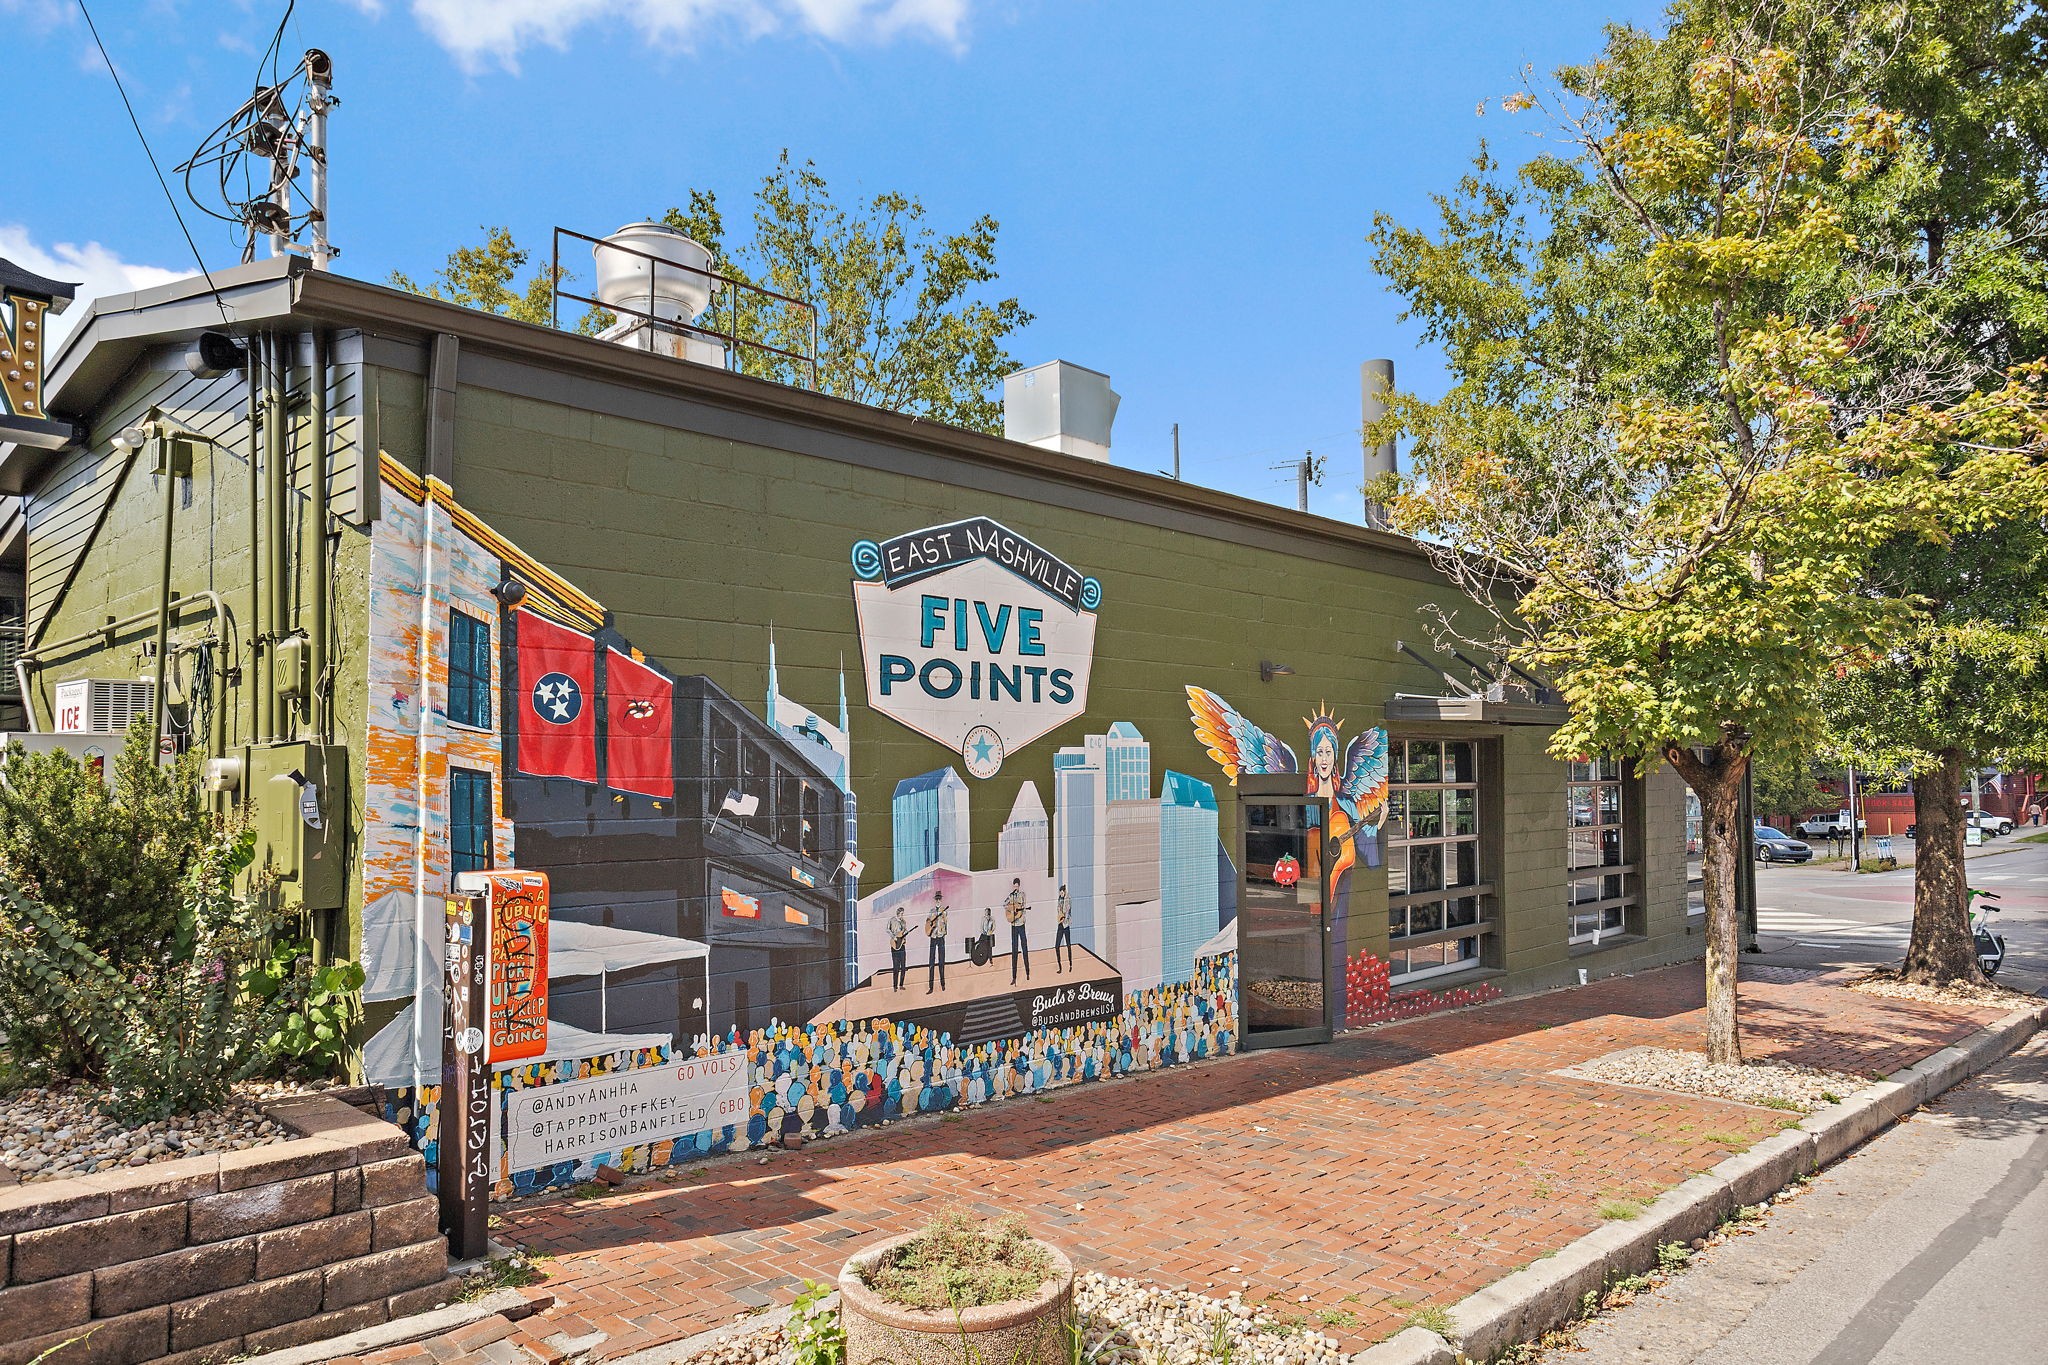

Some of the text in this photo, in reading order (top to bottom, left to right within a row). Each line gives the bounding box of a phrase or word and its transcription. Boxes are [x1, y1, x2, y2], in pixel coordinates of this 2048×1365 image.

[888, 526, 1077, 600] EAST NASHVILLE
[920, 594, 1046, 656] FIVE
[879, 654, 1075, 704] POINTS
[61, 706, 80, 731] ICE
[850, 861, 857, 871] T
[536, 889, 545, 902] A
[493, 904, 547, 929] PUBLIC
[492, 961, 526, 980] PICK
[492, 981, 512, 1006] UP
[1032, 983, 1115, 1016] Buds & Brews
[491, 997, 545, 1019] and KEEP
[491, 1020, 508, 1030] THE
[493, 1028, 545, 1047] GOING
[677, 1057, 737, 1081] GO VOLS
[719, 1097, 744, 1115] GBO
[545, 1108, 706, 1154] HARRISONBANFIELD
